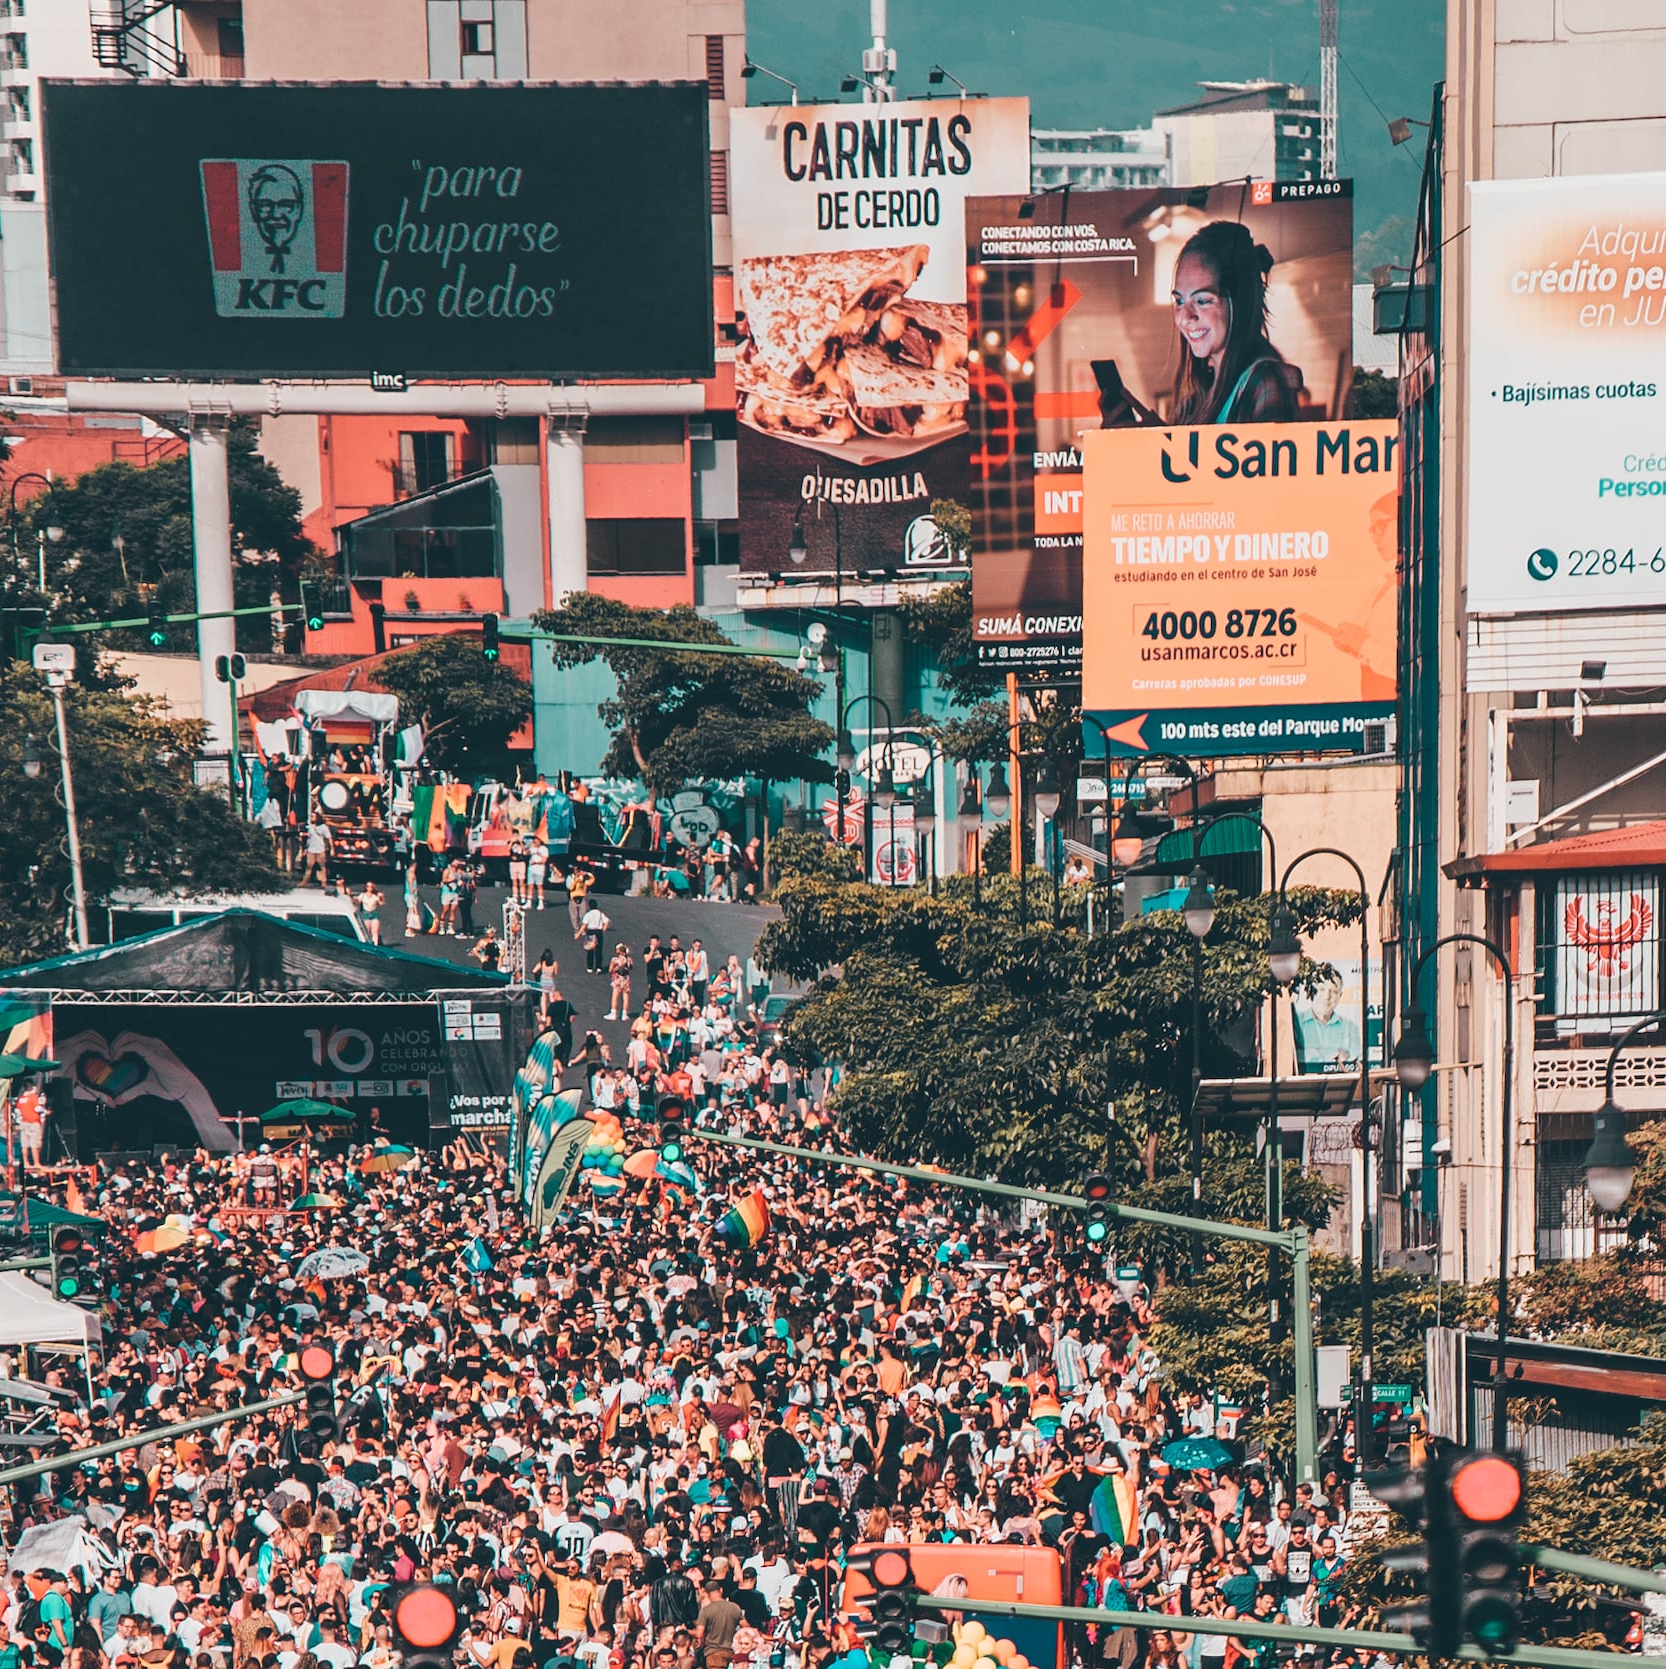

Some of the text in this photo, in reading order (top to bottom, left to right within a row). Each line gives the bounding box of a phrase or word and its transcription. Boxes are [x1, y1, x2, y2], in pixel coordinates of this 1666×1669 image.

[783, 114, 972, 182] CARNITAS
[1281, 183, 1341, 197] PREPAGO
[817, 187, 940, 230] DE CERDO
[373, 196, 561, 269] chuparse
[981, 226, 1050, 240] CONECTANDO
[1051, 225, 1073, 239] CON
[981, 240, 1052, 254] CONECTAMOS
[1053, 240, 1074, 253] CON
[1075, 239, 1108, 252] COSTA
[374, 259, 426, 318] los
[1510, 260, 1617, 297] crédito
[234, 279, 326, 311] KFC
[1579, 301, 1615, 327] en
[373, 371, 404, 386] imc
[1502, 381, 1657, 407] Bajísimas cuotas
[1034, 448, 1076, 469] ENVIÁ
[1213, 433, 1298, 479] San
[1111, 511, 1235, 532] ME RETO A AHORRAR
[1034, 536, 1073, 549] TODA LA
[1111, 530, 1329, 565] TIEMPO Y DINERO
[1114, 565, 1317, 583] estudiando en el centro de San José
[977, 613, 1022, 635] SUMÁ
[1142, 608, 1297, 640] 4000 8726
[1141, 641, 1298, 662] usanmarcos.ac.cr
[1132, 674, 1307, 691] Carreras aprobadas por CONESUP
[1161, 722, 1184, 739] 100
[1189, 722, 1219, 738] mts
[1222, 721, 1256, 737] este
[1258, 718, 1283, 736] del
[1286, 717, 1340, 738] Parque
[381, 1027, 430, 1045] AÑOS
[381, 1062, 406, 1073] CON
[450, 1094, 505, 1109] ¿Vos por
